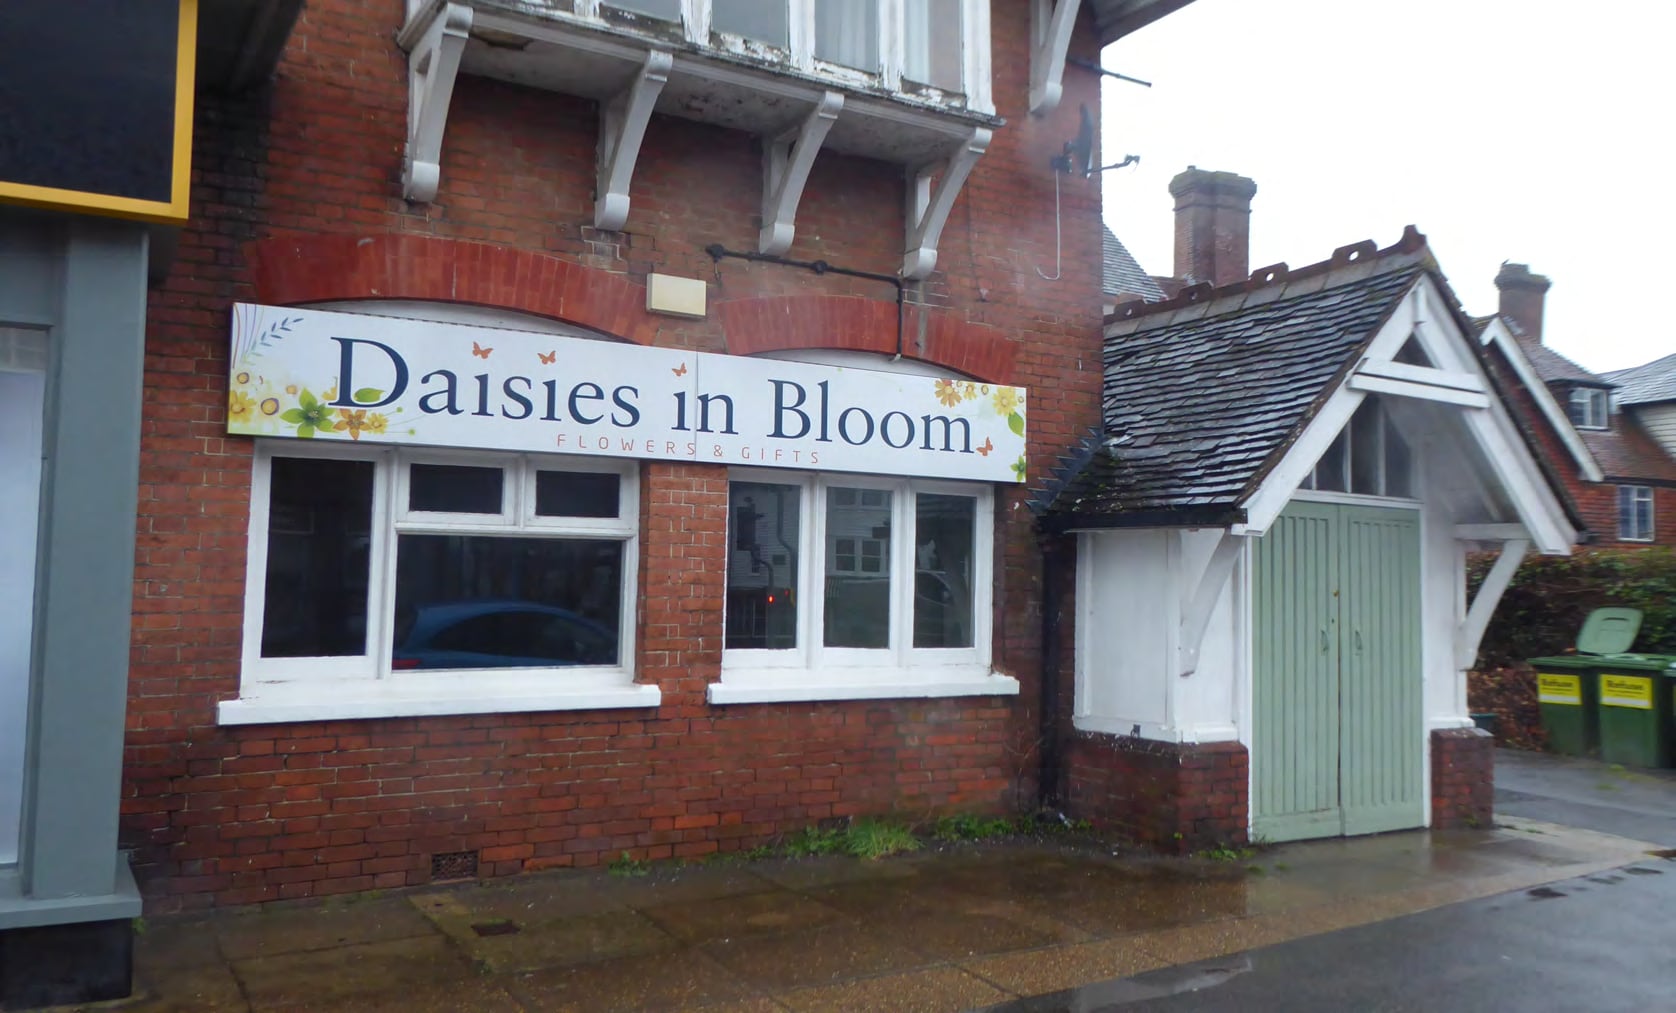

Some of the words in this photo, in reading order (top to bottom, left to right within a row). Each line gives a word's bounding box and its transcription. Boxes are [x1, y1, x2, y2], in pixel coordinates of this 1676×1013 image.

[327, 336, 640, 429] Daisies
[671, 390, 739, 436] in
[766, 379, 976, 454] Bloom
[556, 433, 696, 456] FLOWERS
[712, 444, 724, 458] &
[741, 446, 819, 465] GIFTS
